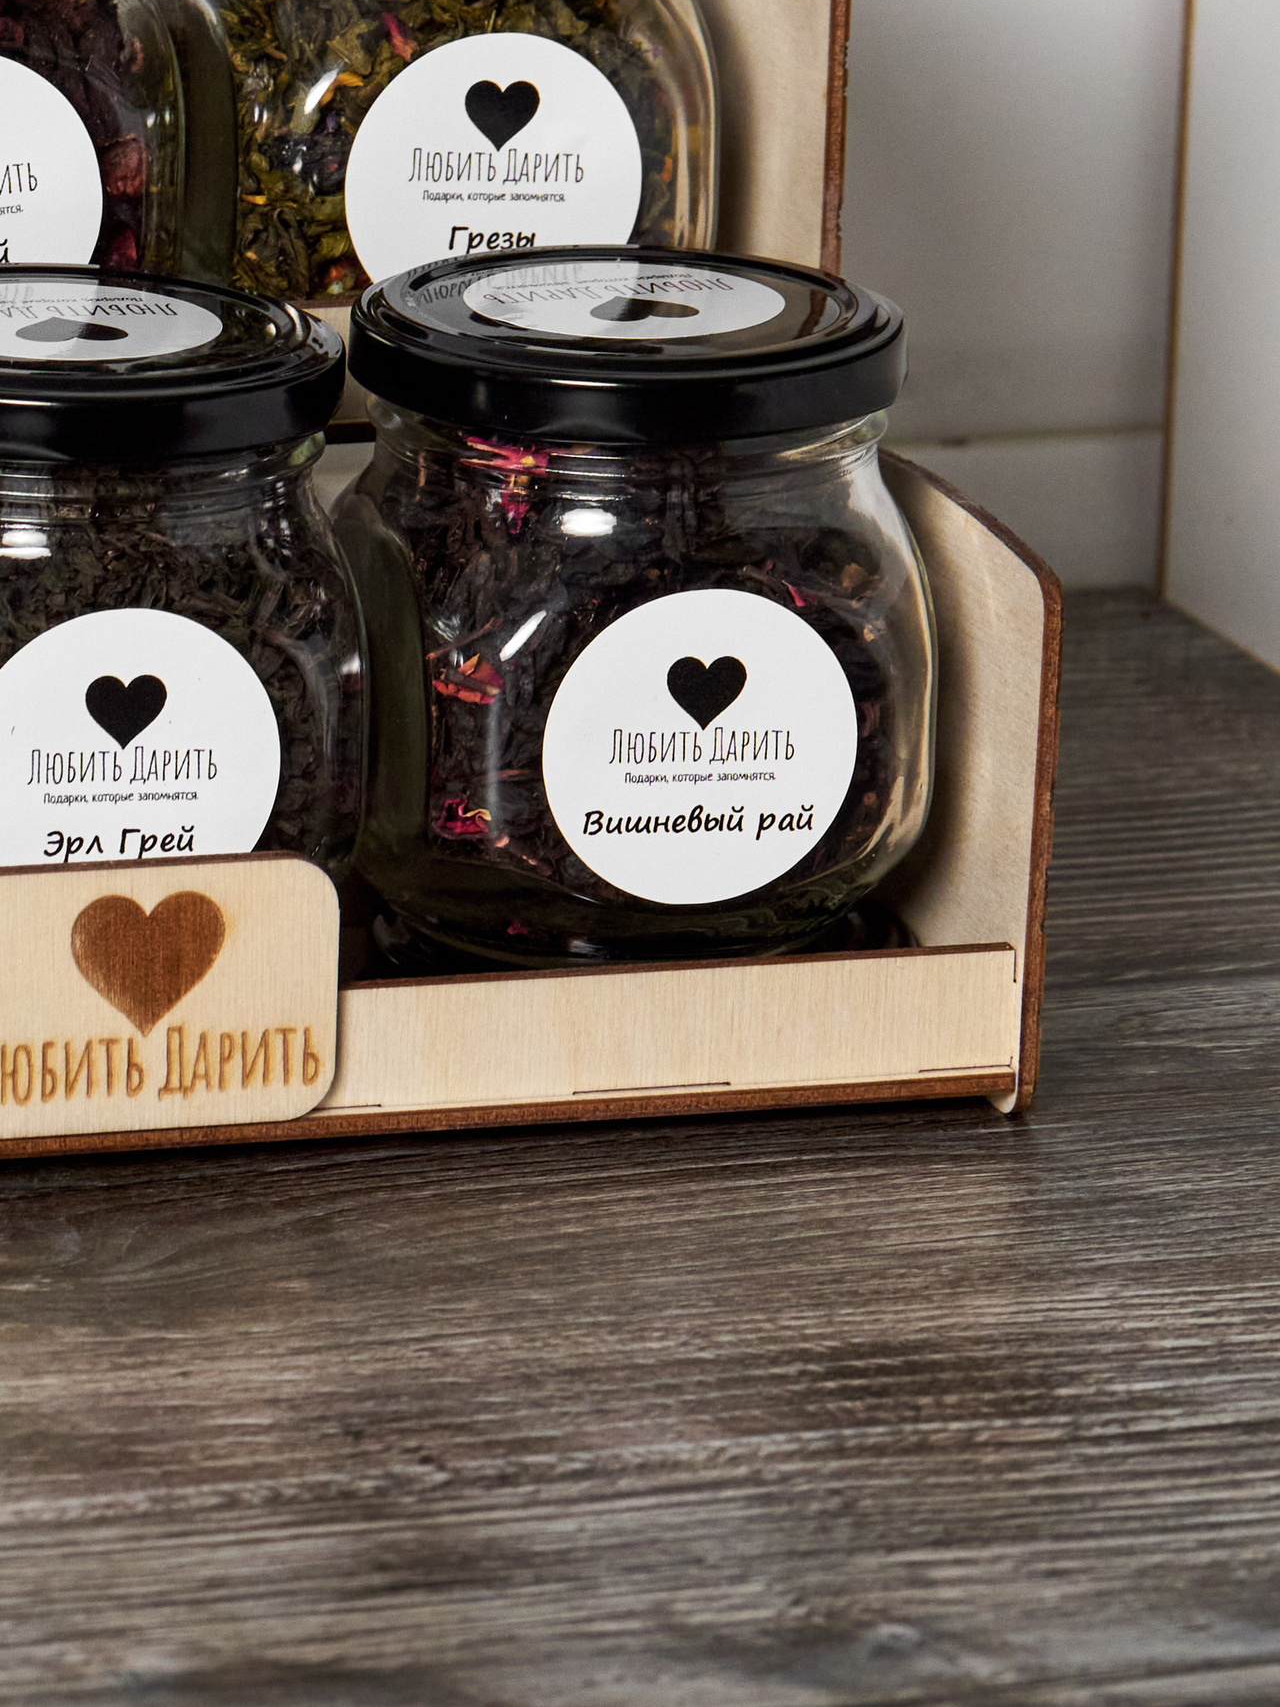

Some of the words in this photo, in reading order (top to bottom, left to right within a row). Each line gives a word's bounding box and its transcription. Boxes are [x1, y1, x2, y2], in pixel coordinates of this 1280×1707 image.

[408, 147, 497, 183] ЛЮБИТЬ
[502, 148, 584, 186] ДАРИТЬ
[467, 192, 507, 204] которые
[448, 225, 537, 255] Грезы
[608, 728, 703, 765] ЛЮБИТЬ
[708, 726, 795, 765] ДАРИТЬ
[27, 748, 123, 786] ЛЮБИТЬ
[129, 745, 218, 785] ДАРИТЬ
[672, 773, 714, 786] которые
[91, 792, 135, 805] которые
[582, 804, 745, 836] Вишневый
[755, 804, 815, 841] рай
[42, 830, 105, 864] Эрл
[119, 824, 196, 860] Грей
[159, 1025, 320, 1098] ДАРИТЬ
